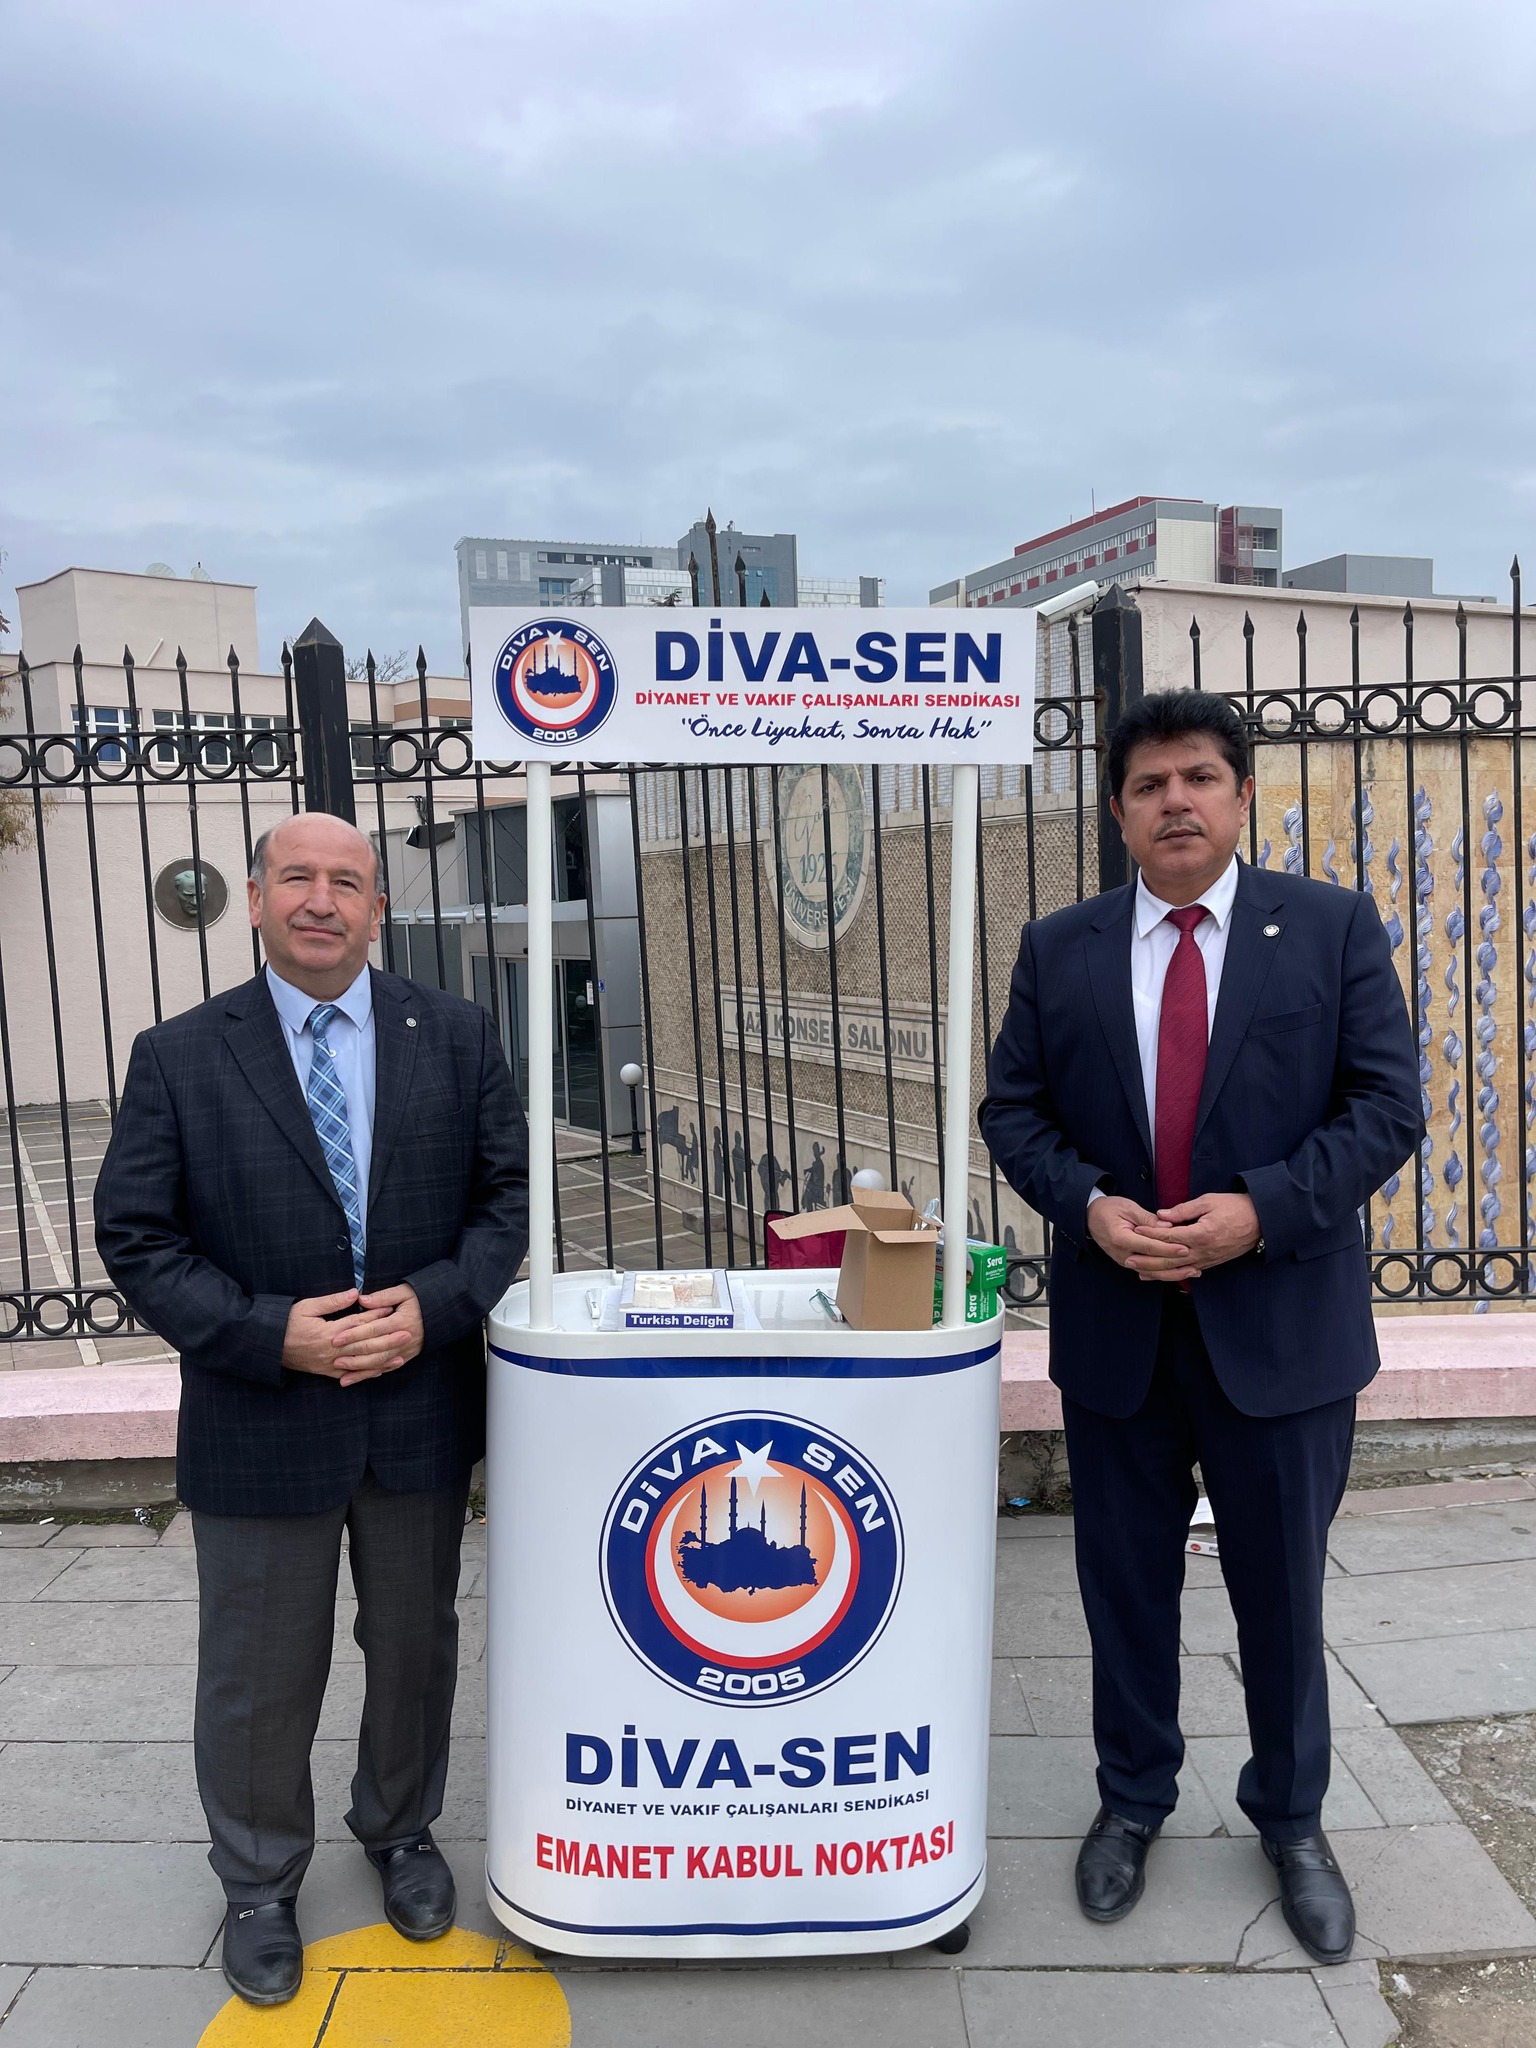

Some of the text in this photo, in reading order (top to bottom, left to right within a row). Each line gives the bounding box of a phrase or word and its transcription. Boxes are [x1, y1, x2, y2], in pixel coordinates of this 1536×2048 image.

[574, 629, 610, 672] SEN
[655, 618, 1002, 683] DİVA-SEN
[635, 690, 1020, 709] DİYANET VE VAKIF ÇALIŞANLARI SENDİKASI
[532, 727, 579, 742] 2005
[751, 715, 846, 746] Liyakat,
[853, 718, 925, 739] Sonra
[986, 1256, 1004, 1268] Sera
[967, 1293, 977, 1318] Sera
[630, 1314, 730, 1328] Turkish Delight
[802, 1442, 886, 1533] SEN
[696, 1666, 806, 1696] 2005
[565, 1724, 931, 1789] DİVA-SEN
[566, 1789, 930, 1819] DİYANET VE VAKIF ÇALIŞANLARI SENDİKASI
[536, 1820, 954, 1879] EMANET KABUL NOKTASI
